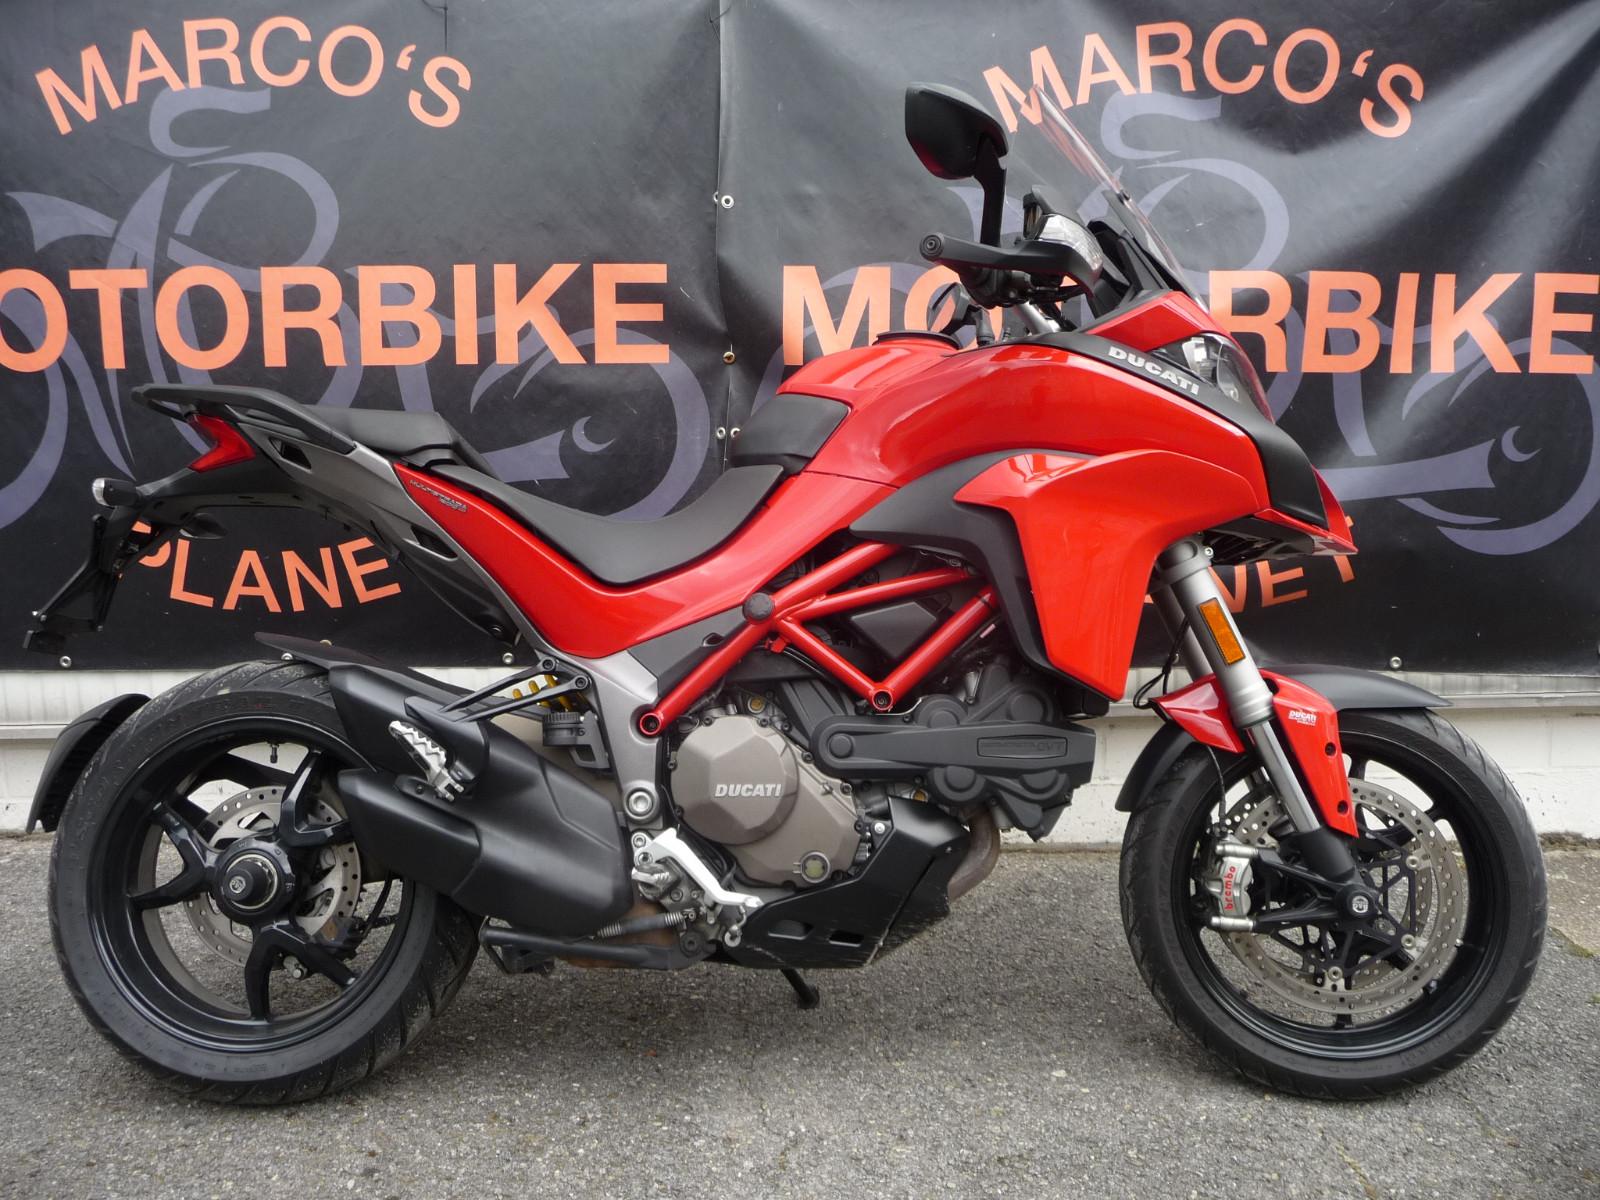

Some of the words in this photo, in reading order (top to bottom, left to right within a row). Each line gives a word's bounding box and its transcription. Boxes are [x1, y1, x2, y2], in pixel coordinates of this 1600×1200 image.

[1108, 346, 1200, 395] DUCATI
[714, 784, 782, 797] DUCATI
[1224, 865, 1236, 911] brembo
